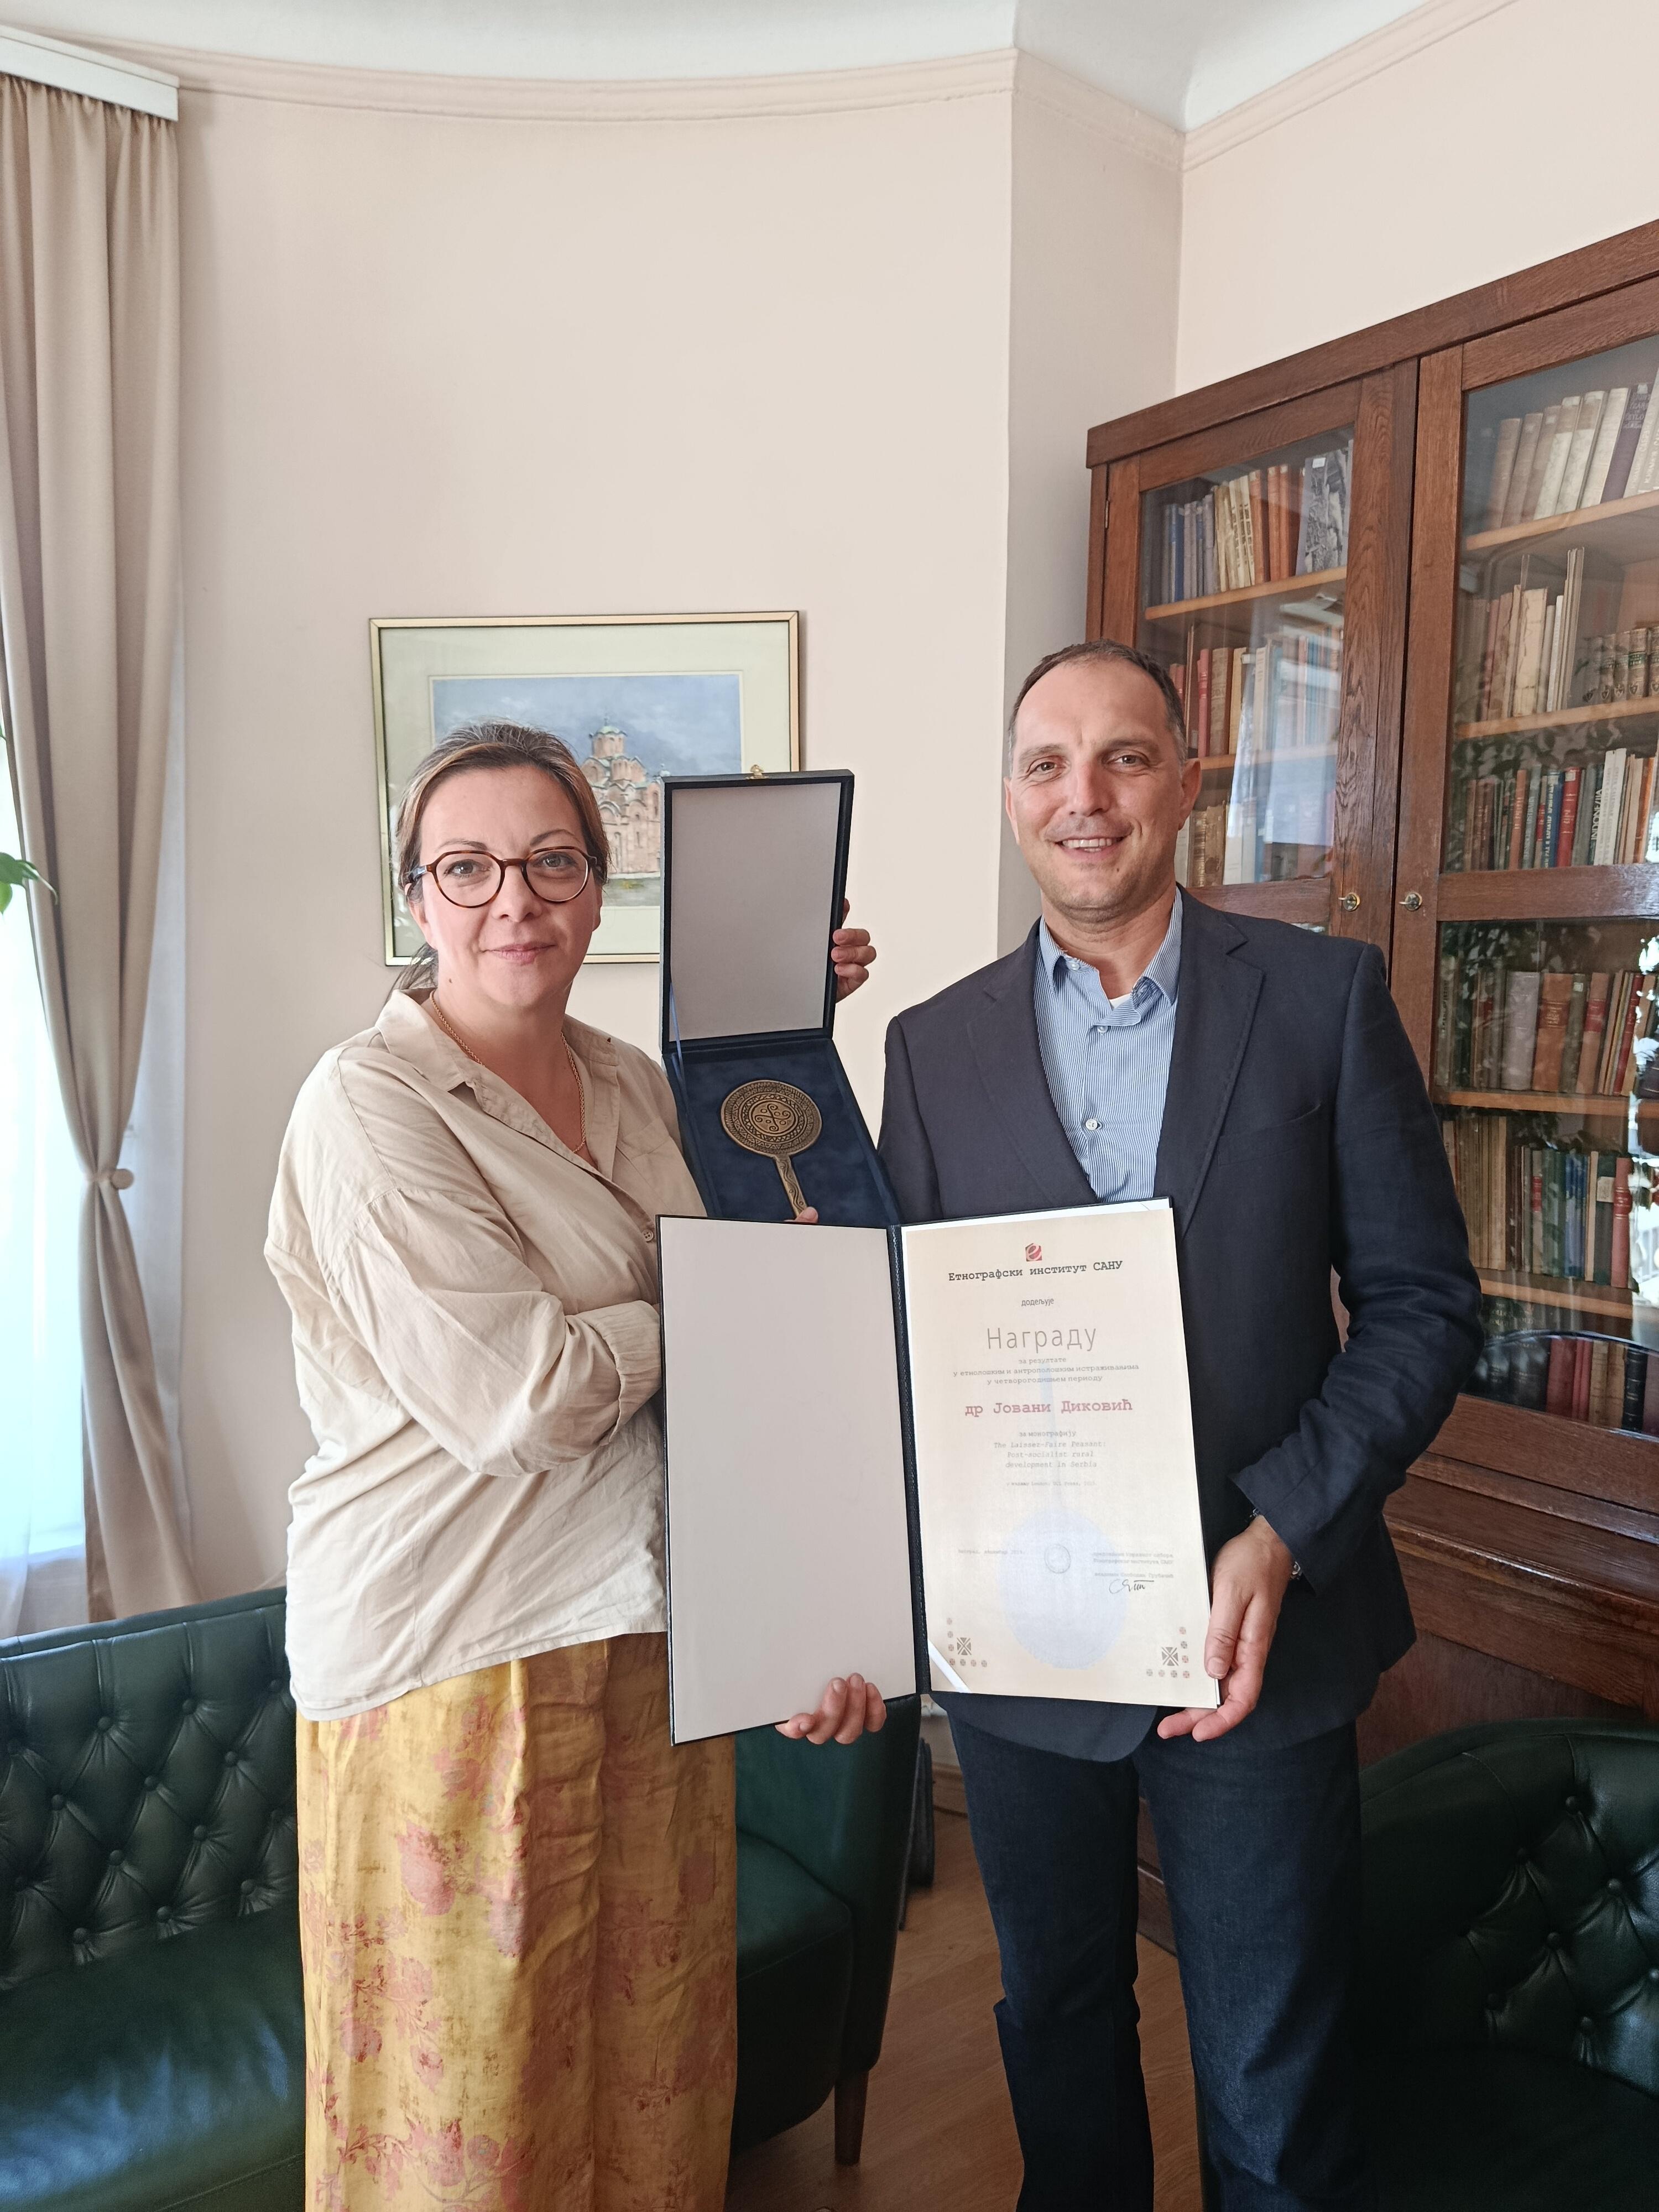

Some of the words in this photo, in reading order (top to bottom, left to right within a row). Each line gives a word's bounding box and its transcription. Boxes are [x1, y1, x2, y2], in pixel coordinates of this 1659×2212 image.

[948, 1269, 1023, 1281] Етнографски
[1030, 1264, 1087, 1275] институт
[1093, 1260, 1123, 1271] САНУ
[1021, 1297, 1055, 1307] додељује
[987, 1327, 1097, 1353] Награду
[1014, 1366, 1074, 1374] антрополошким
[1076, 1364, 1139, 1372] истраживањима
[965, 1405, 983, 1417] др
[993, 1402, 1051, 1414] Јовани
[1061, 1399, 1133, 1414] Диковић
